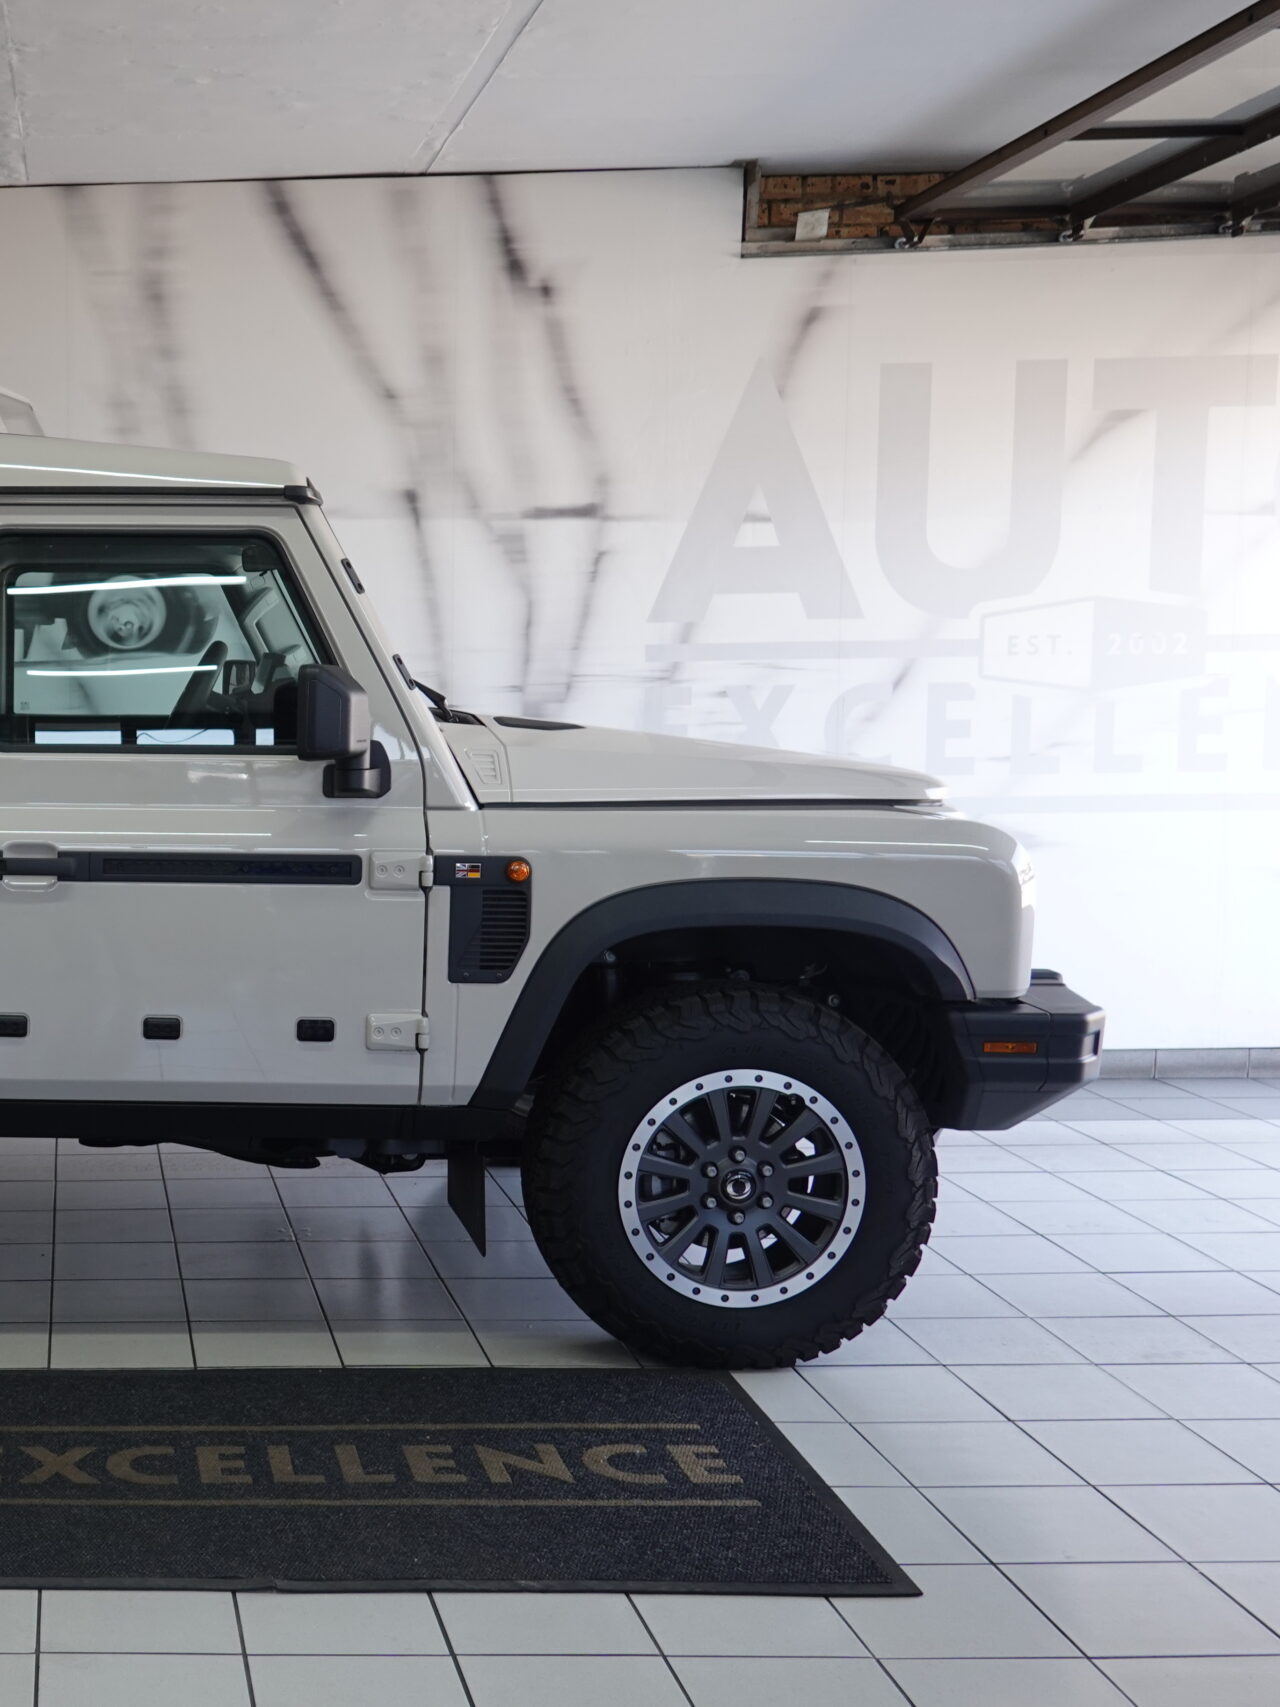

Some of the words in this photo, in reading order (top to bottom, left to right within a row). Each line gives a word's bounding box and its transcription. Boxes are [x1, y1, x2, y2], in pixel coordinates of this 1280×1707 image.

[646, 356, 1280, 622] AUT
[1006, 633, 1073, 657] EST.
[1107, 632, 1189, 656] 2002
